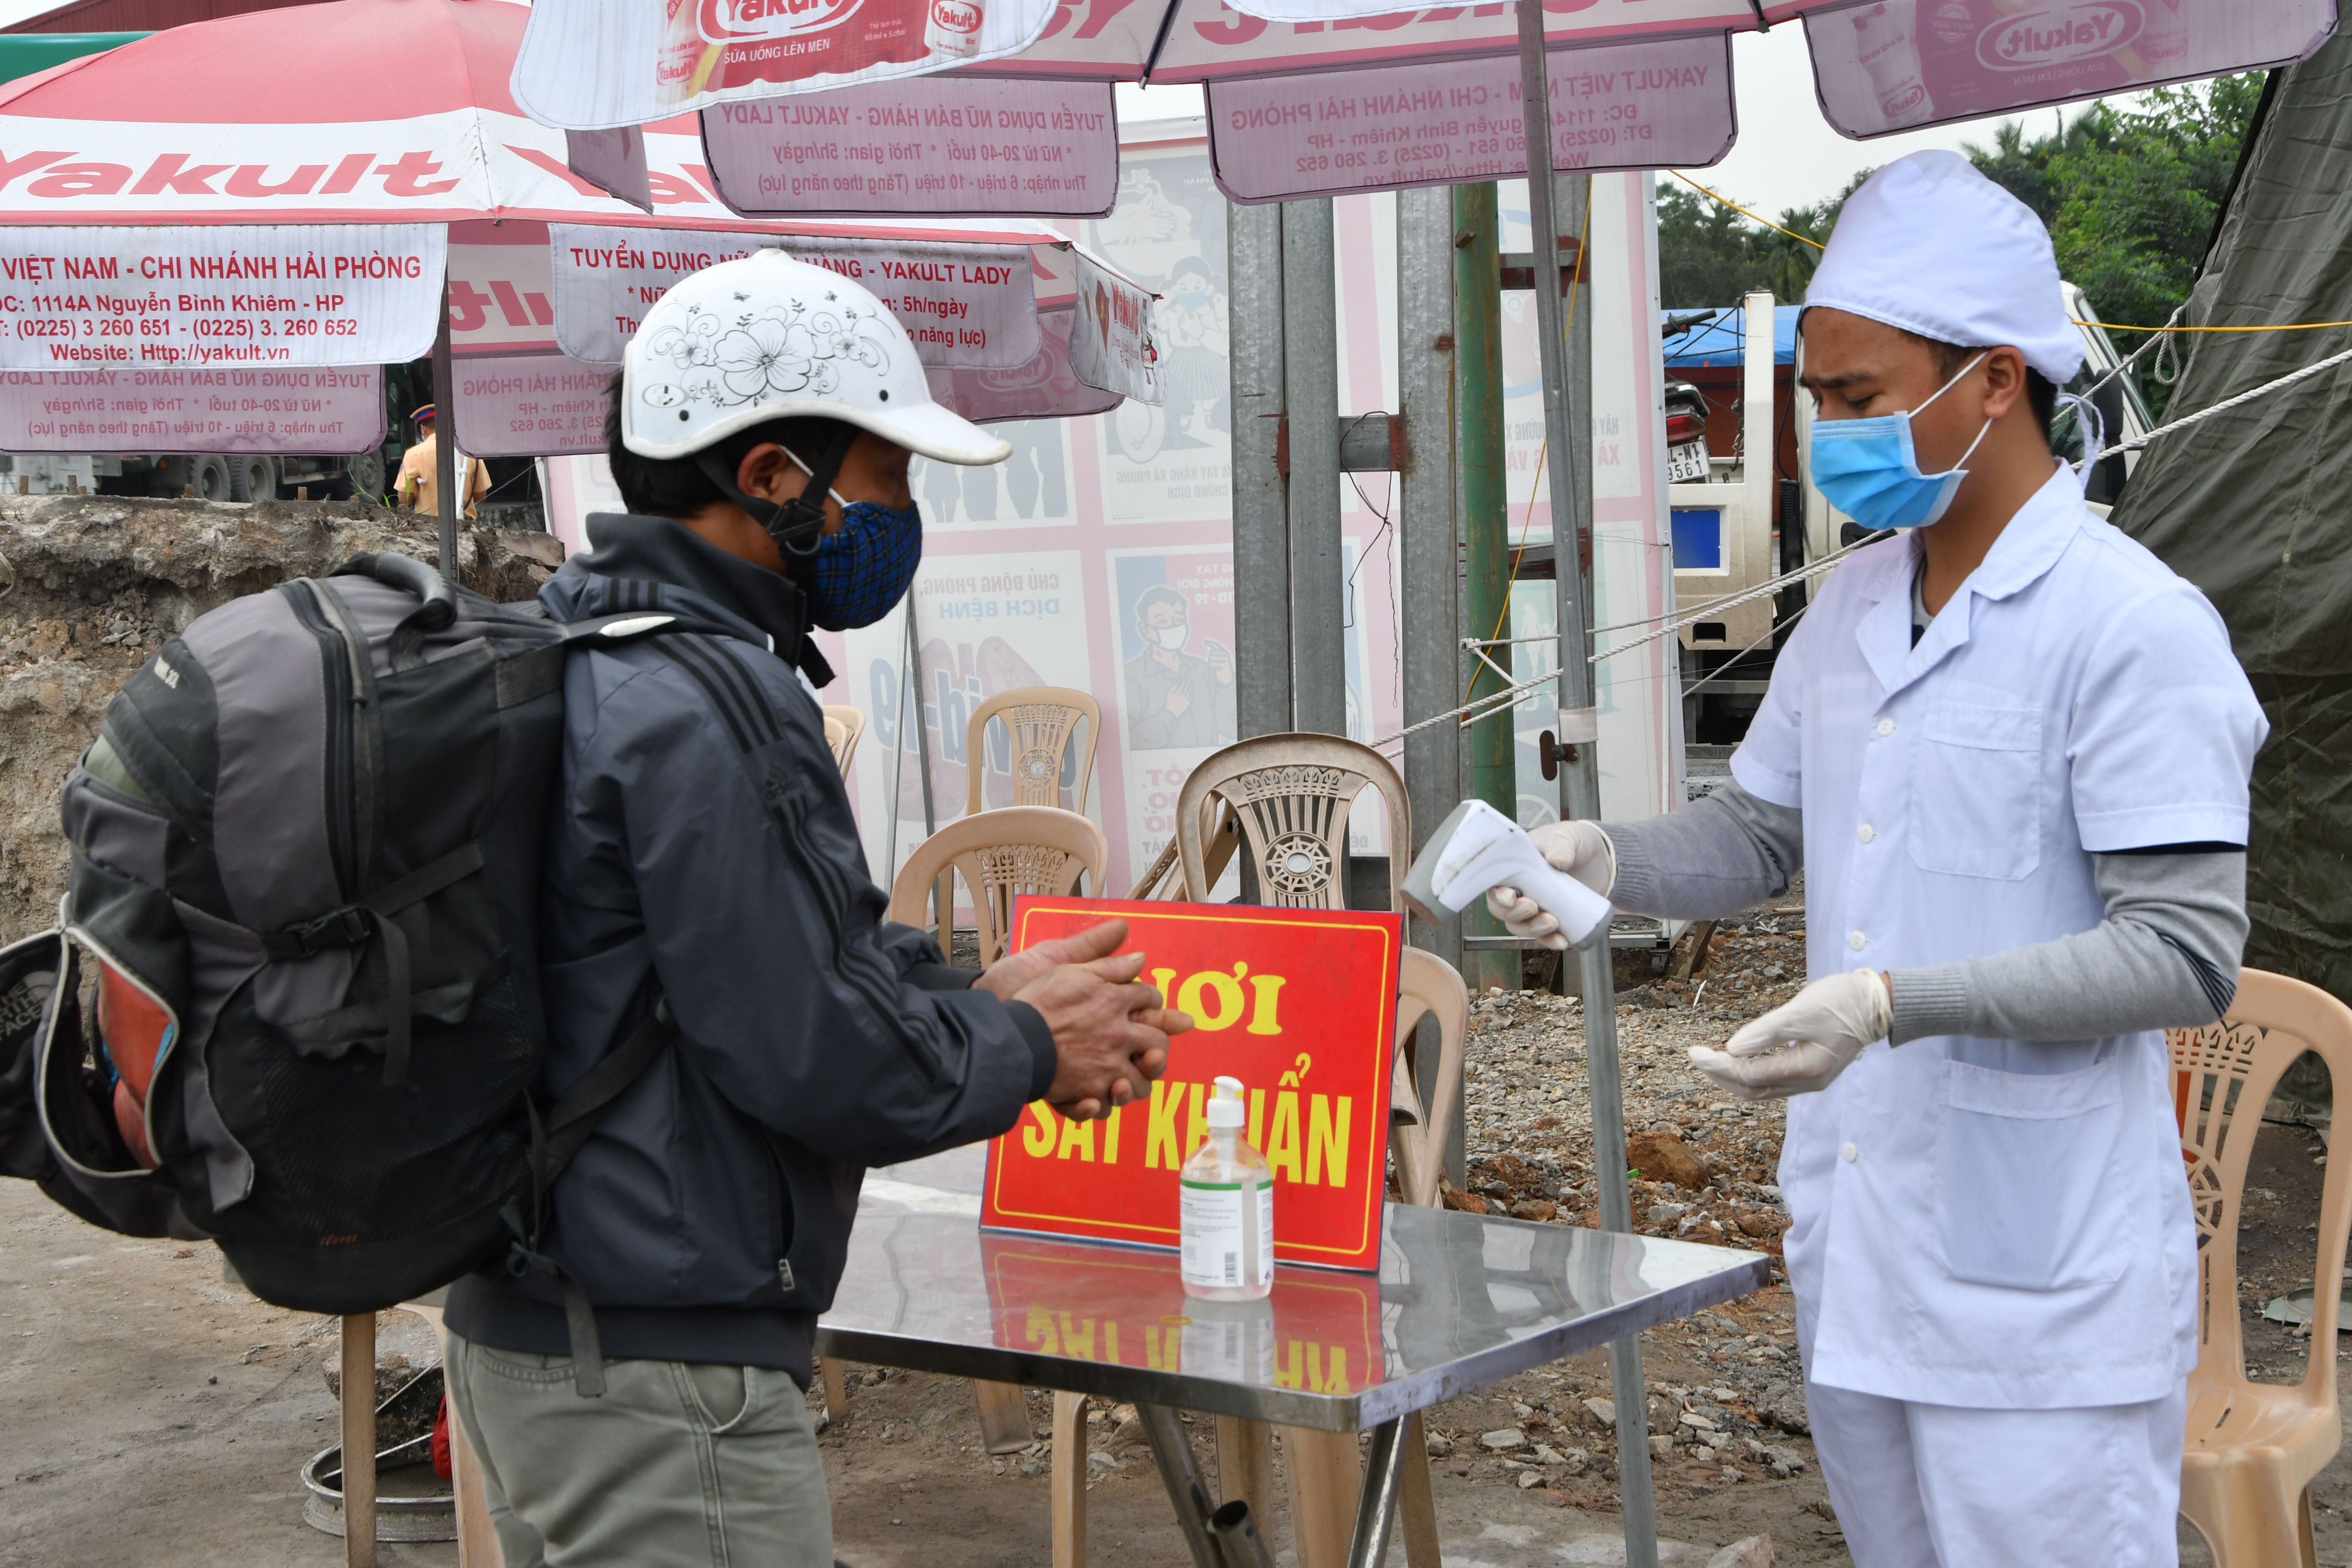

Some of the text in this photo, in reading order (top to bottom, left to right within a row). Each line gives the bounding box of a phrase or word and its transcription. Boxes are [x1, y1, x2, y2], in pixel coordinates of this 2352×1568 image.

[938, 4, 973, 28] Yakult
[724, 38, 830, 64] SỮA UỐNG LÊN MEN
[0, 150, 461, 197] Yakult
[2, 250, 421, 286] VIỆT NAM CHI NHÁNH HẢI PHÒNG
[570, 240, 645, 269] TUYỂN
[653, 250, 712, 274] DỤNG
[881, 261, 956, 282] YAKULT
[963, 266, 1011, 286] LADY
[32, 295, 92, 312] 1114A
[96, 291, 170, 316] Nguyễn
[178, 294, 224, 311] Bỉnh
[232, 294, 296, 312] Khiêm
[316, 294, 344, 311] HP
[904, 296, 968, 319] 5h/ngày
[17, 319, 76, 340] (0225)
[83, 320, 93, 336] 3
[100, 319, 133, 336] 260
[141, 319, 170, 336] 651
[193, 319, 253, 340] (0225)
[261, 319, 277, 336] 3.
[284, 319, 318, 336] 260
[324, 319, 357, 335] 652
[919, 327, 954, 348] năng
[959, 328, 986, 349] lực)
[50, 343, 290, 365] Website: Http://yakult.vn
[1668, 443, 1700, 464] 4-N1
